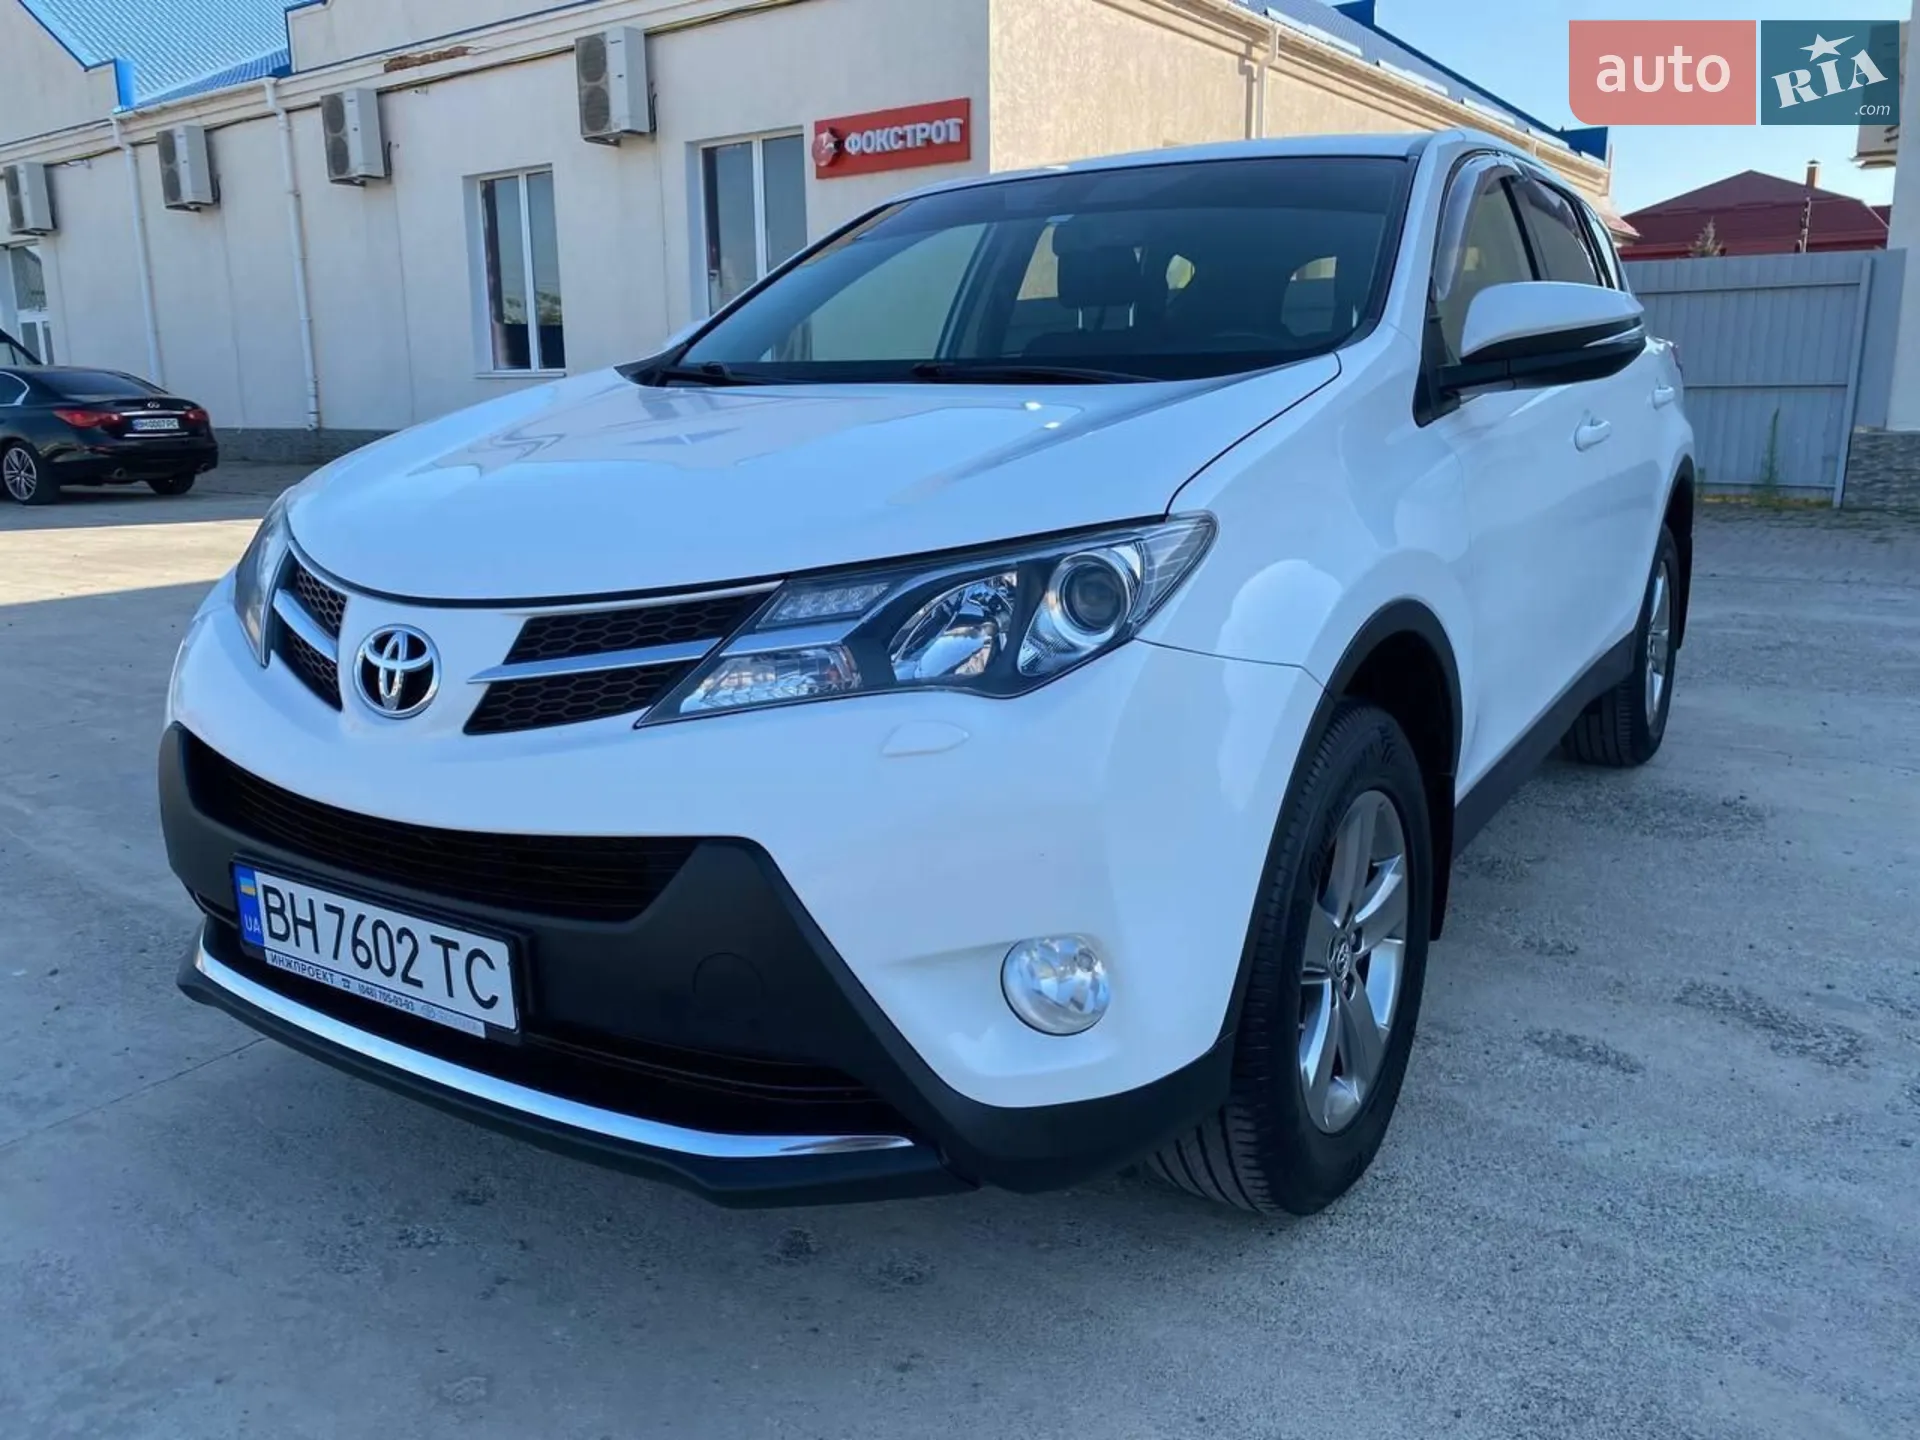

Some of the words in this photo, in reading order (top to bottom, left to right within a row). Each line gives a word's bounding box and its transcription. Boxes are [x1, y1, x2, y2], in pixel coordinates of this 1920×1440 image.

[845, 117, 963, 155] ФОКСТРОТ
[244, 917, 261, 934] UA
[270, 953, 335, 985] ИНЖПРОЕКТ
